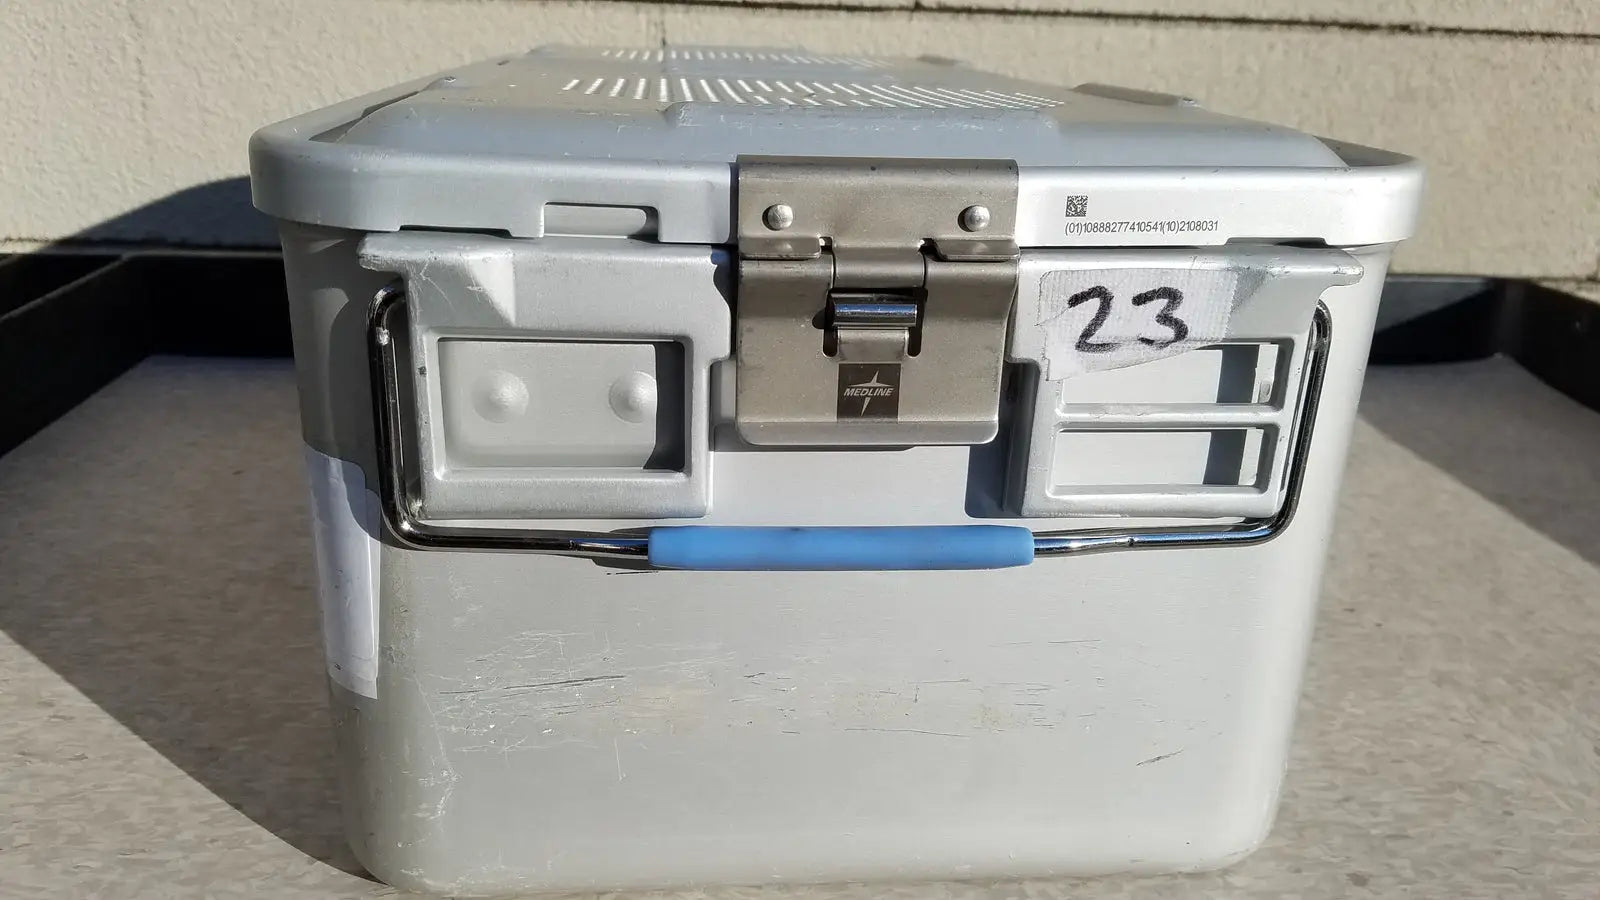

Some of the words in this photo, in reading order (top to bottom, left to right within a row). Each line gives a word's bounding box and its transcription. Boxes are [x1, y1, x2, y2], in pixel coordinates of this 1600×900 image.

[1065, 219, 1219, 236] (01)10888277410541(10)2108031
[1067, 285, 1190, 352] 23
[844, 387, 894, 396] MEDLINE
